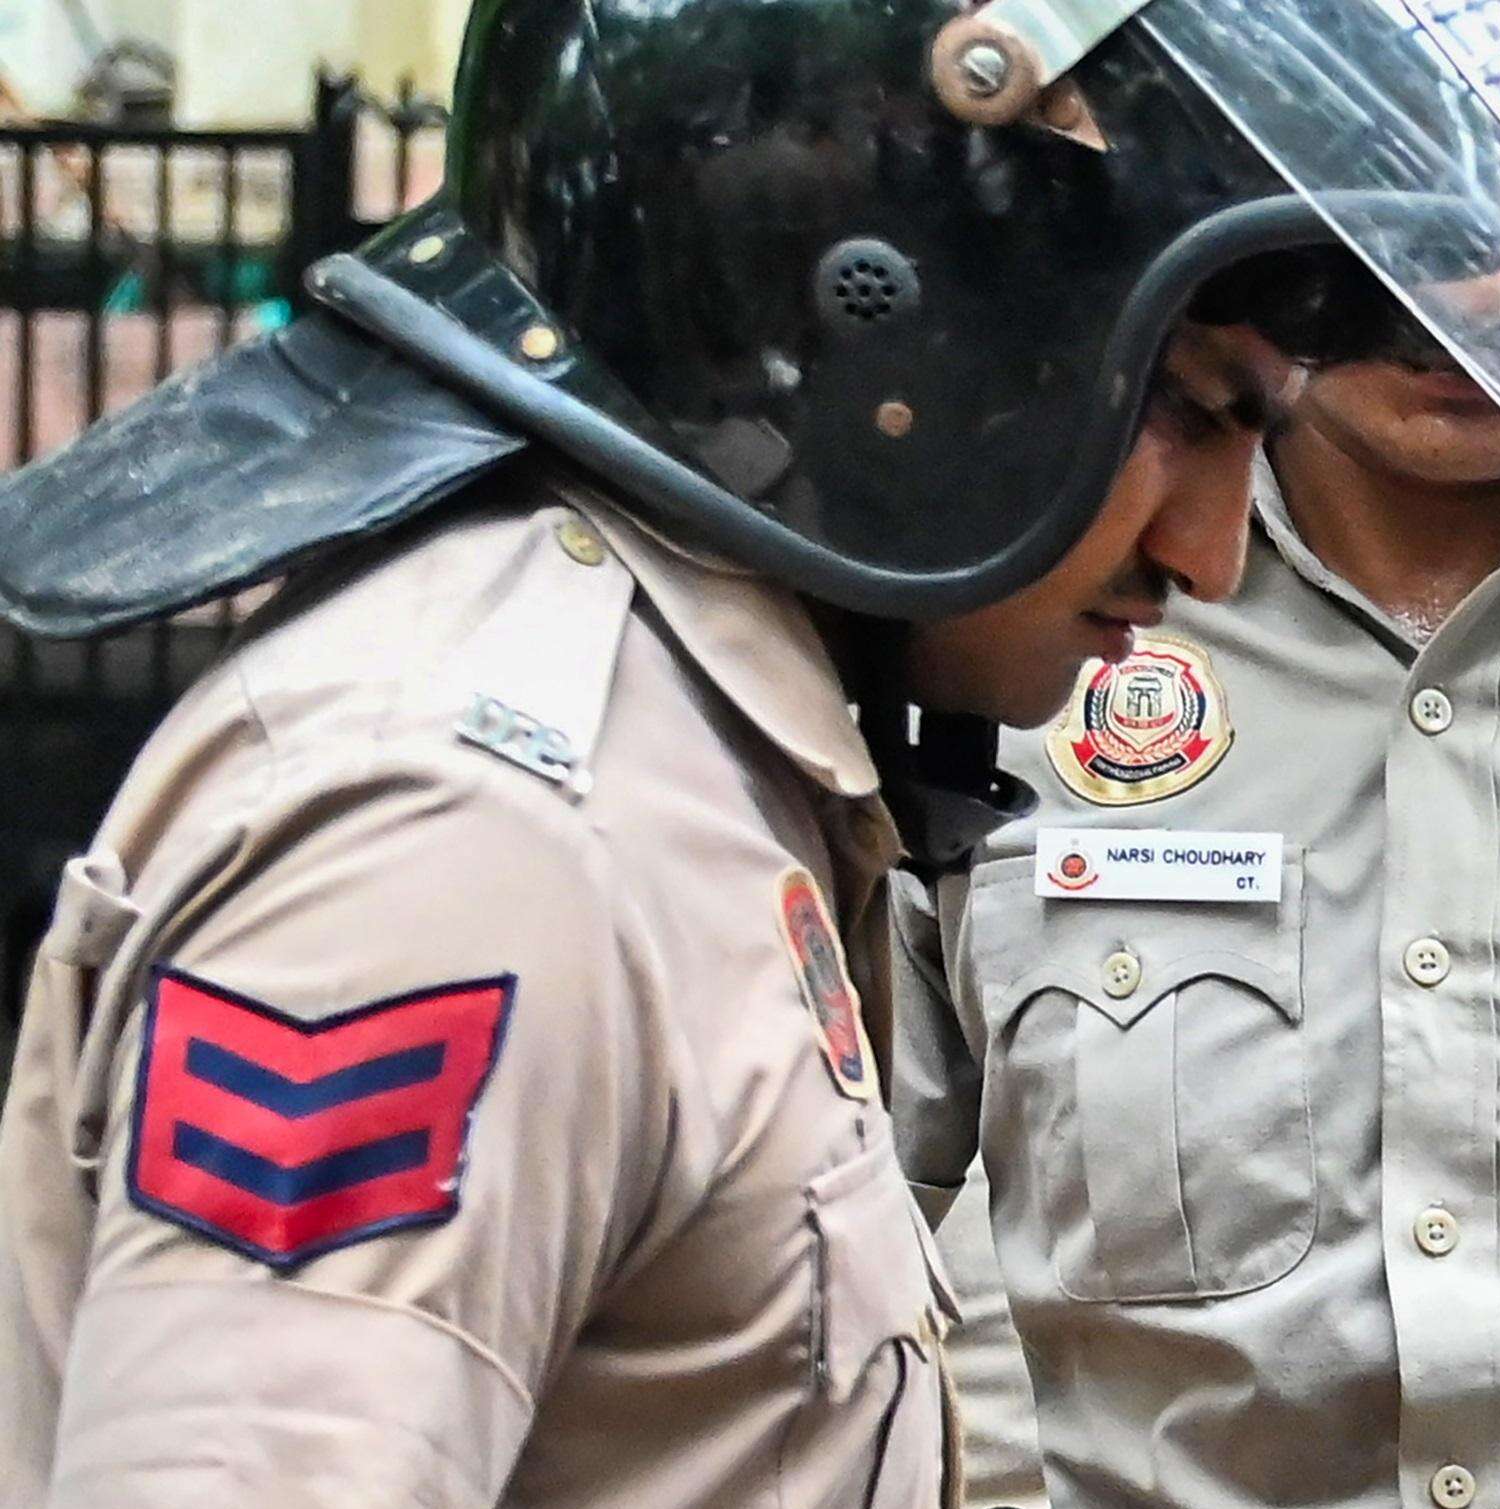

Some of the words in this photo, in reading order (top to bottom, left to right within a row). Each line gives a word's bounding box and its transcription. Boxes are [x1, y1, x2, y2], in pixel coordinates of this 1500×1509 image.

[1106, 847, 1155, 864] NARSI
[1162, 848, 1266, 866] CHOUDHARY
[1235, 876, 1260, 890] CT.
